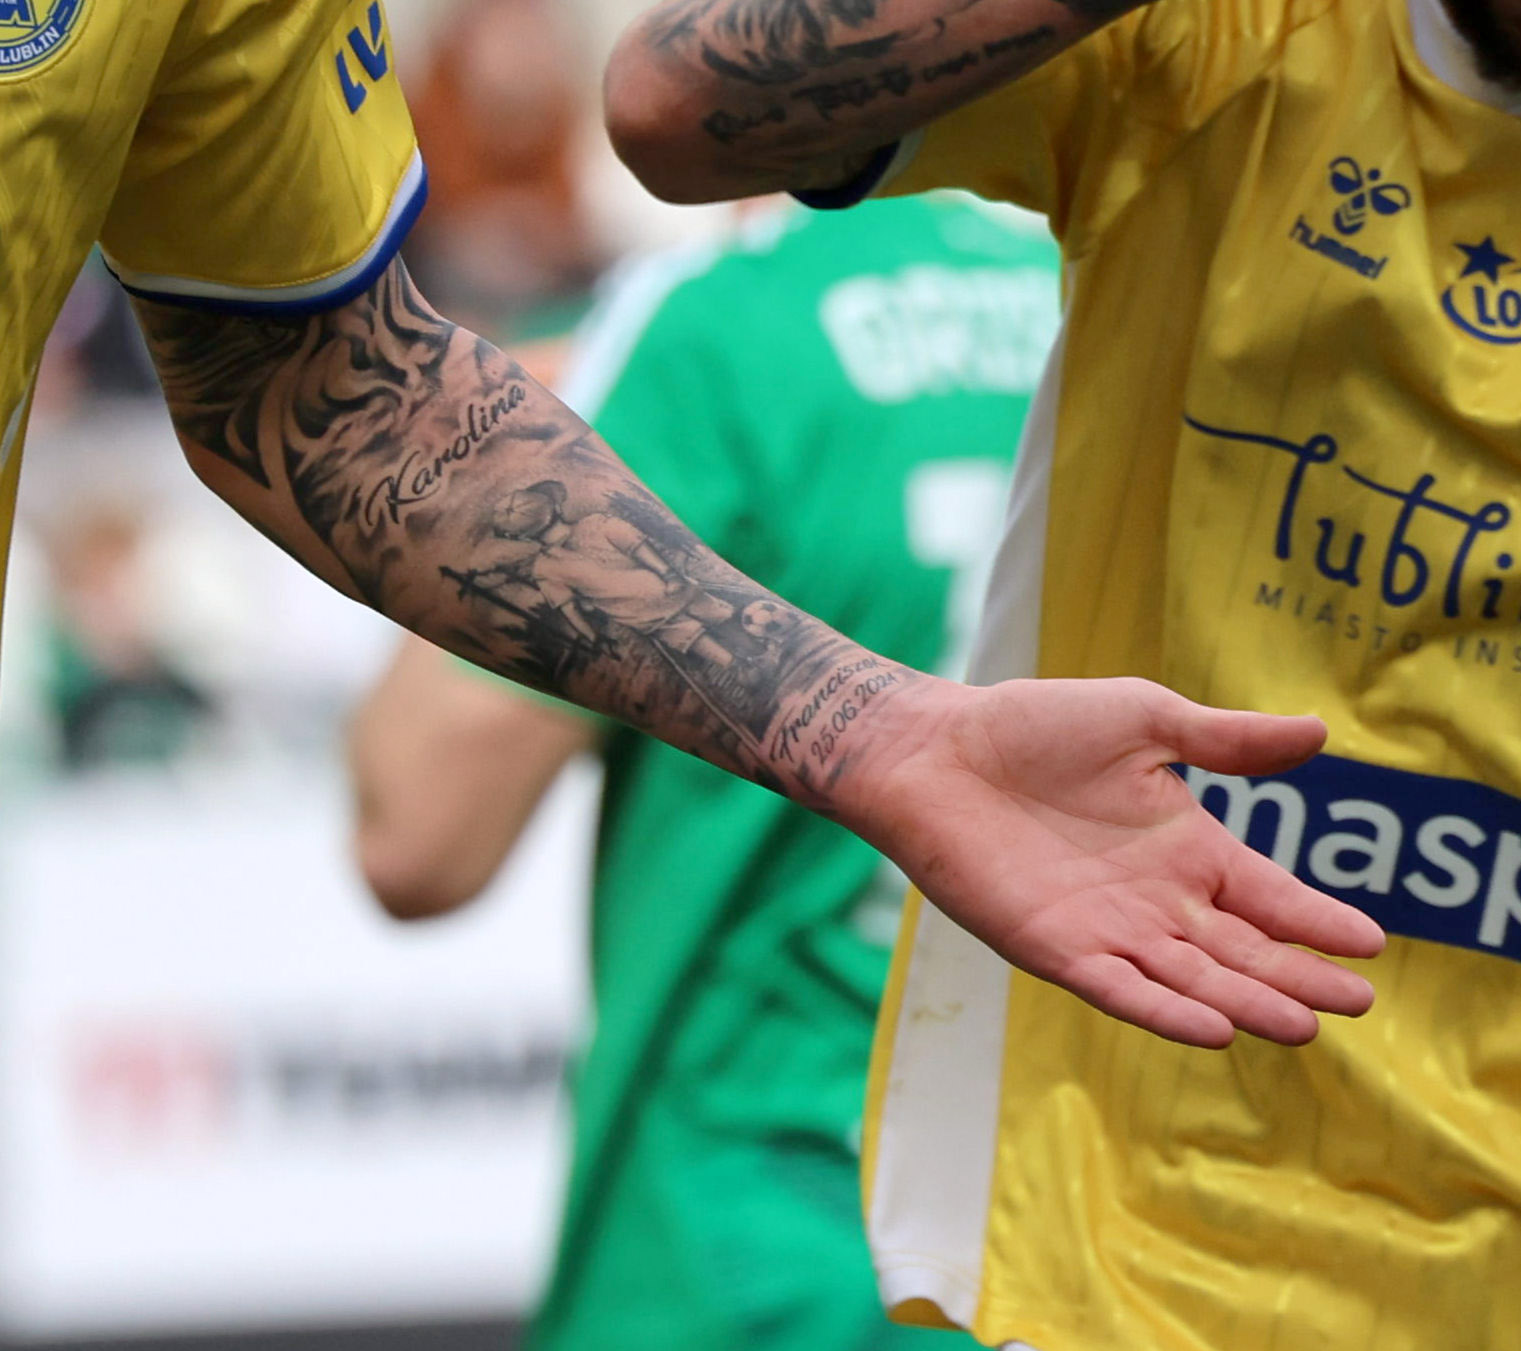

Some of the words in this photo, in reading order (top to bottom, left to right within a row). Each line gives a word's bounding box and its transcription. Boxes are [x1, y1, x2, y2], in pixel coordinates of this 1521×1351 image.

[0, 27, 60, 64] LUBLIN
[365, 385, 526, 526] Karolina
[1254, 582, 1424, 652] MIASTO
